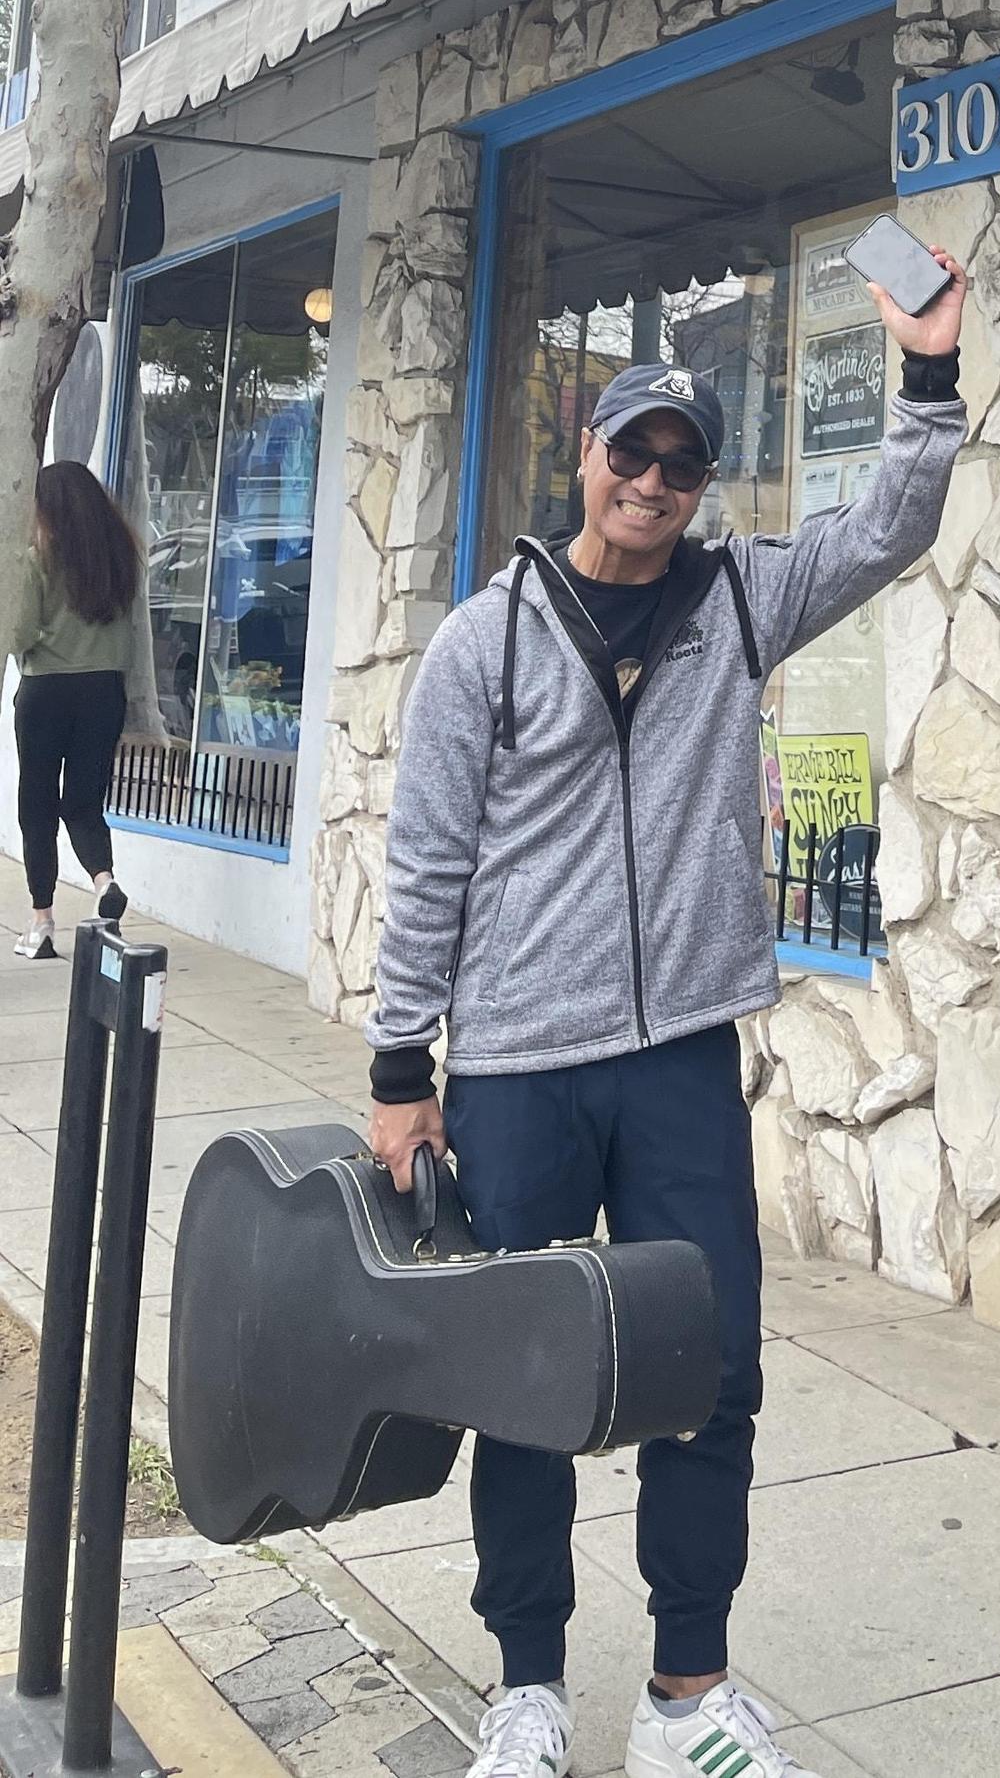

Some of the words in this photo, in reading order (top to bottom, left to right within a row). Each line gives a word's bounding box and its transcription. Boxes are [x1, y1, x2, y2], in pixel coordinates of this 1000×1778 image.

[845, 388, 865, 404] 1833
[851, 416, 876, 429] DEALER
[784, 743, 825, 783] ERNIE
[825, 748, 862, 784] BALL
